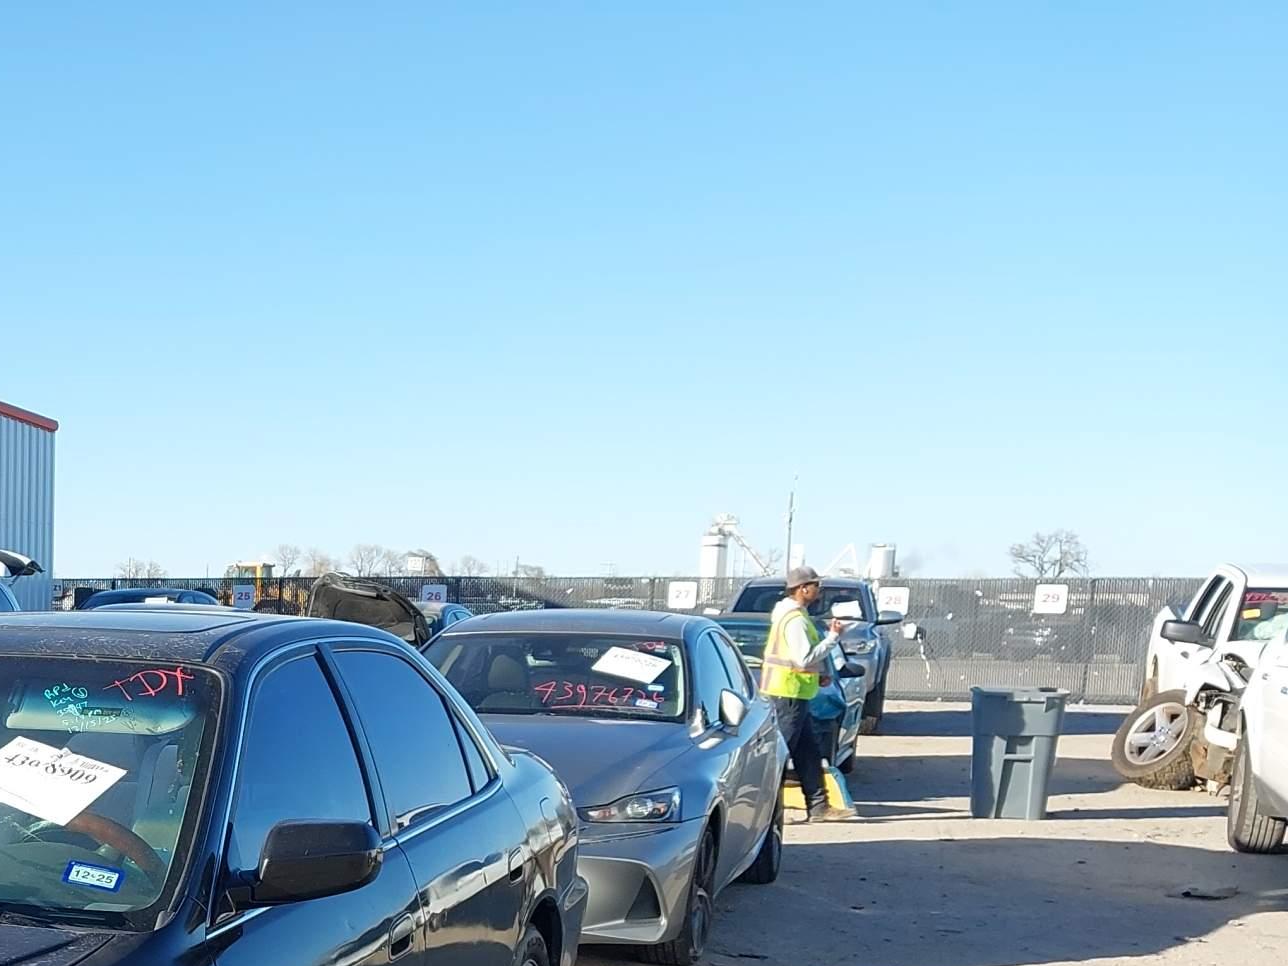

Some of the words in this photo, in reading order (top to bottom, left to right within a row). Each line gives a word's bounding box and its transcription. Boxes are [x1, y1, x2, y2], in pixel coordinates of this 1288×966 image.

[236, 591, 251, 601] 25
[426, 591, 442, 601] 26
[675, 590, 691, 599] 27
[1041, 593, 1060, 603] 29
[884, 596, 903, 605] 28
